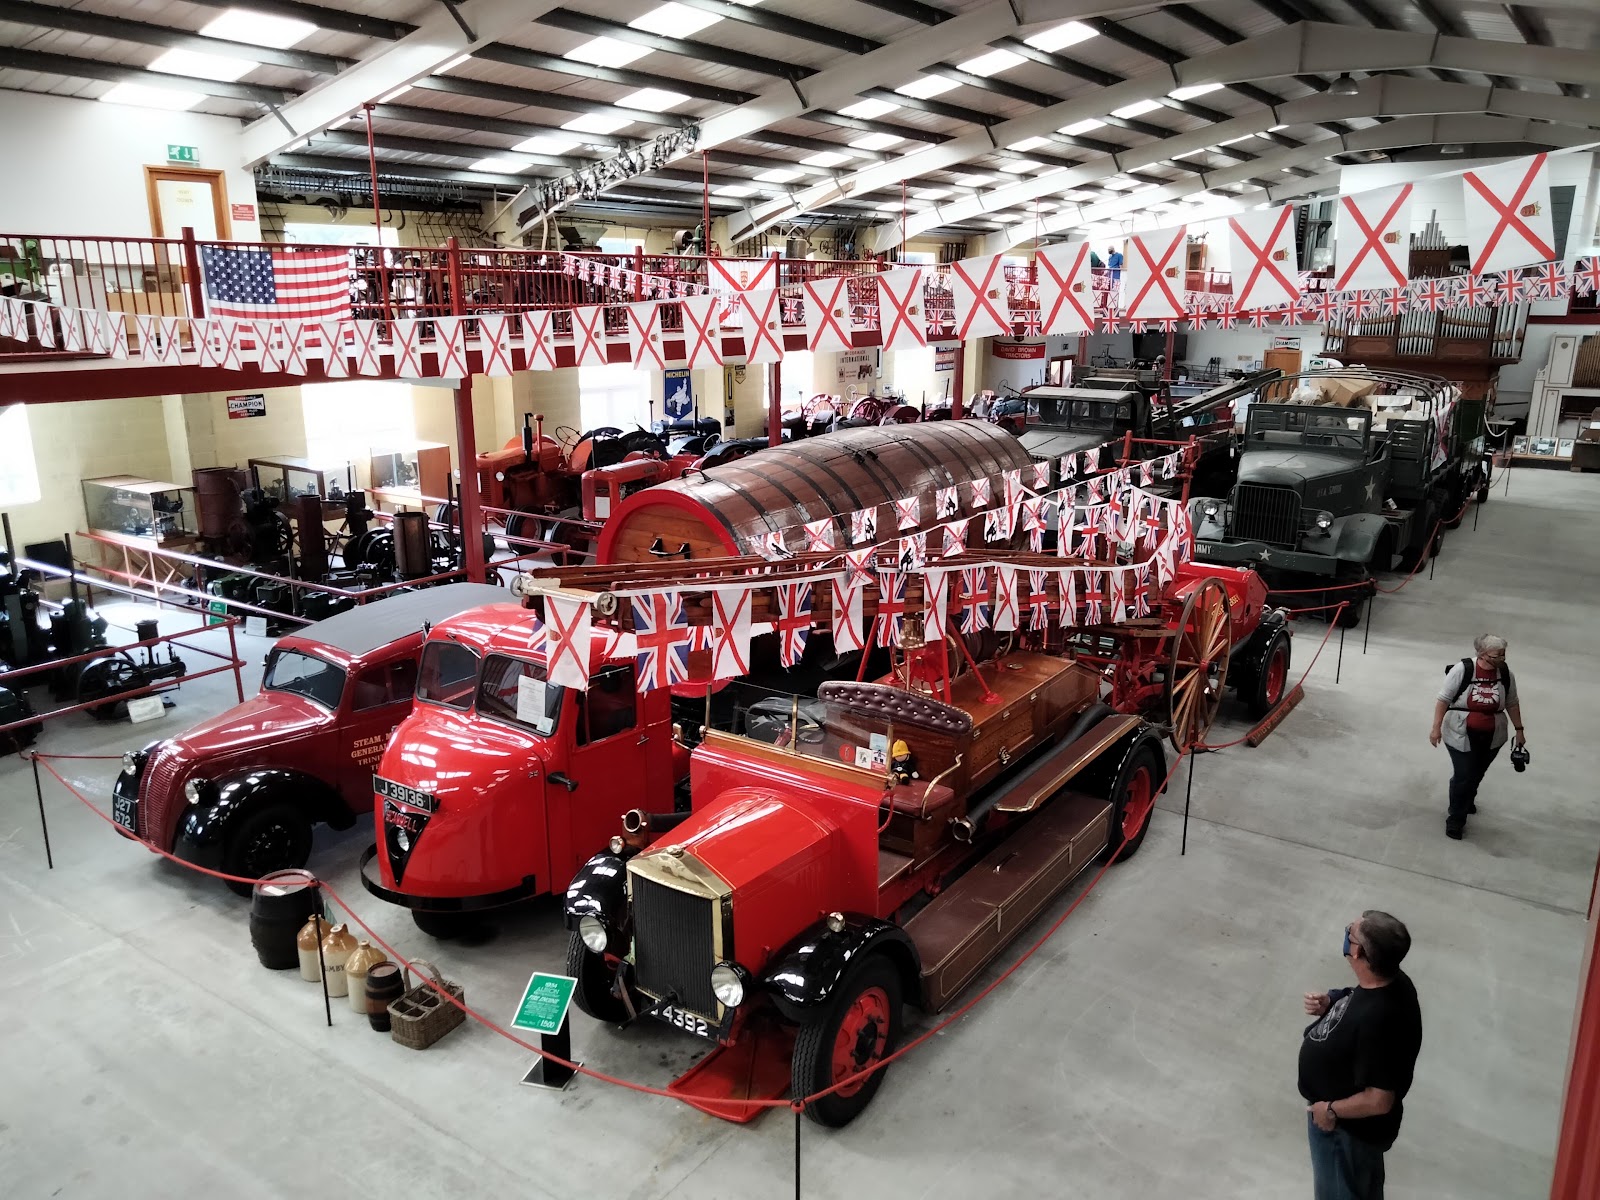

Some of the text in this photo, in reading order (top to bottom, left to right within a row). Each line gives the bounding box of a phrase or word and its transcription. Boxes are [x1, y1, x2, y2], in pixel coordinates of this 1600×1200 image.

[1001, 344, 1037, 353] DAVID BROWN
[840, 355, 870, 363] INTERNATIONAL
[230, 400, 263, 409] CHAMPION
[358, 755, 382, 766] TRINI
[381, 781, 424, 808] J 39136
[115, 797, 131, 813] J27
[115, 810, 131, 828] 572
[662, 1005, 709, 1037] 4392
